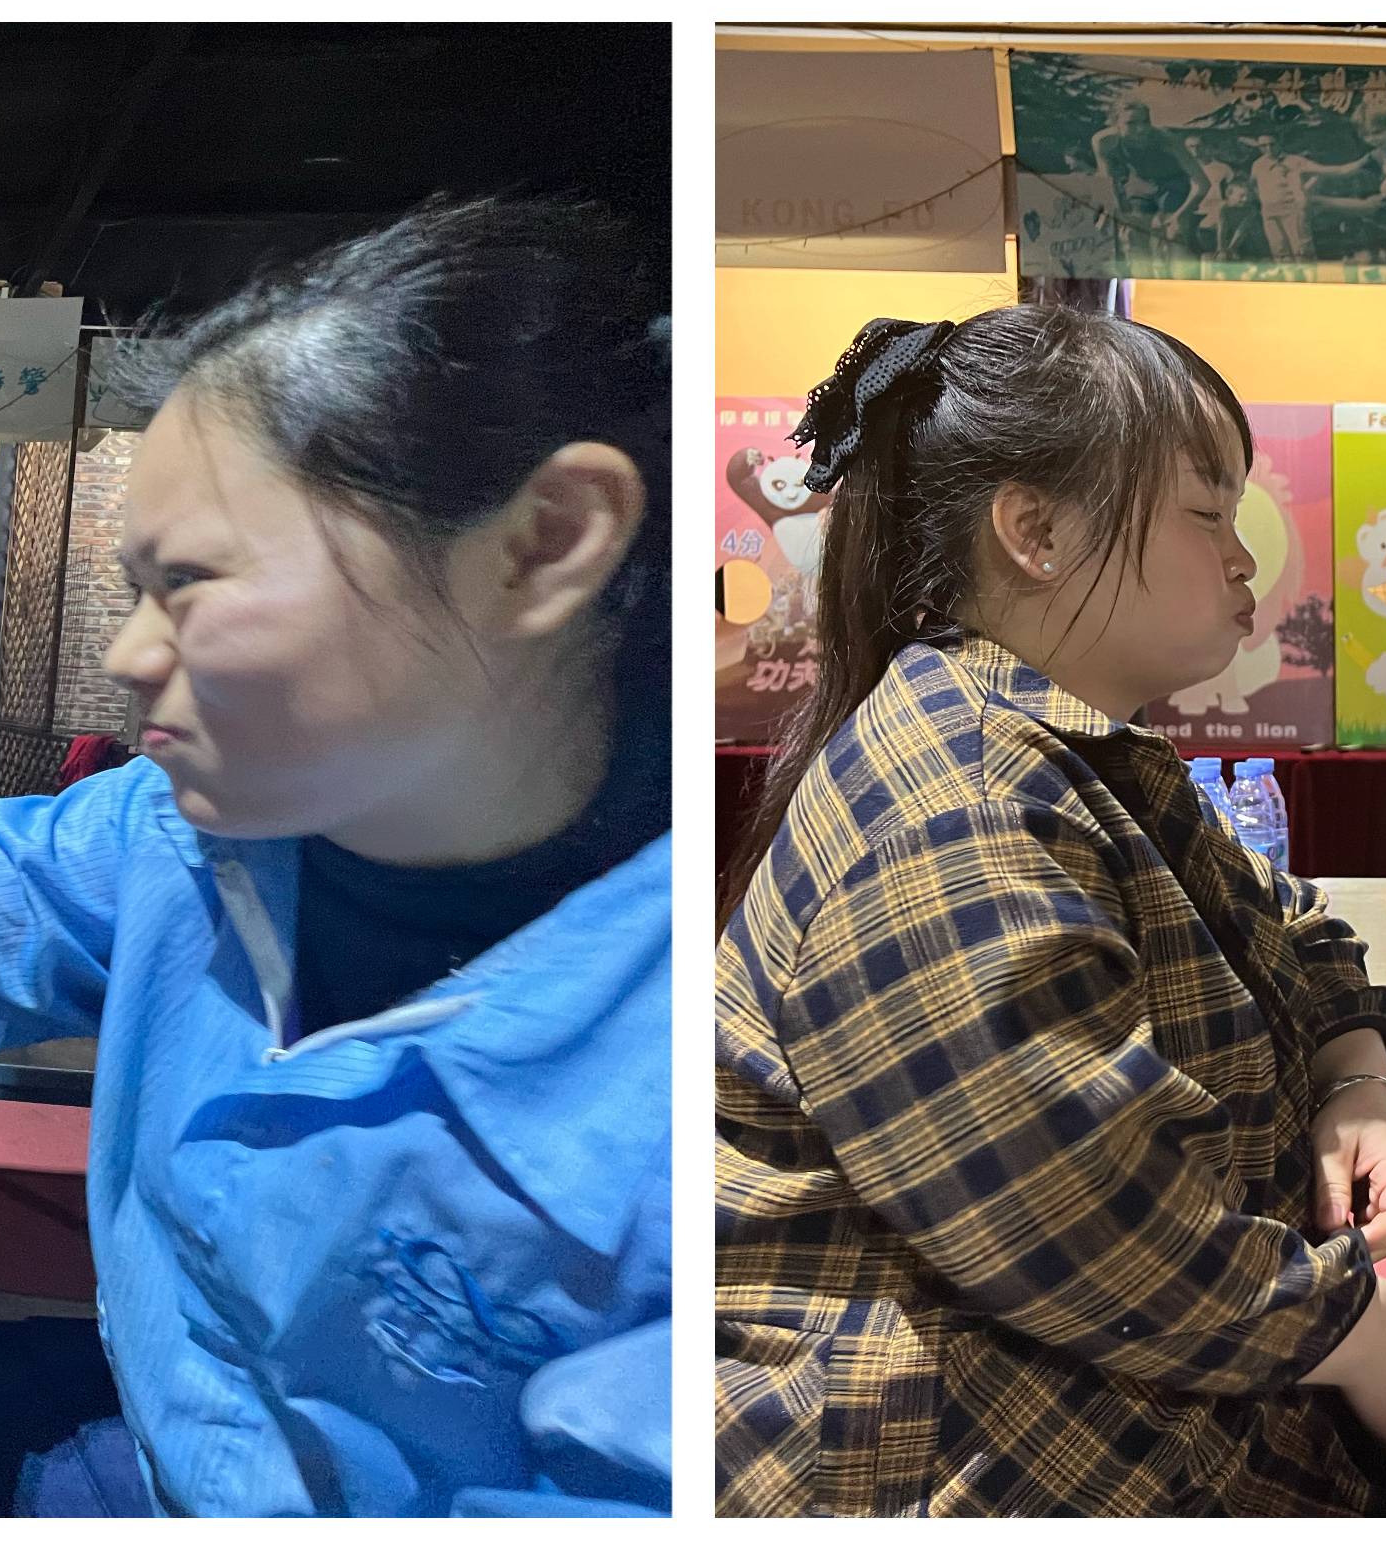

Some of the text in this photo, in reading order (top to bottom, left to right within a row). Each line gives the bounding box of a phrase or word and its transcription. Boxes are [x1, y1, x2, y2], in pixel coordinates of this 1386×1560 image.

[741, 198, 934, 230] KONG FU
[1150, 723, 1297, 737] eed the lion
